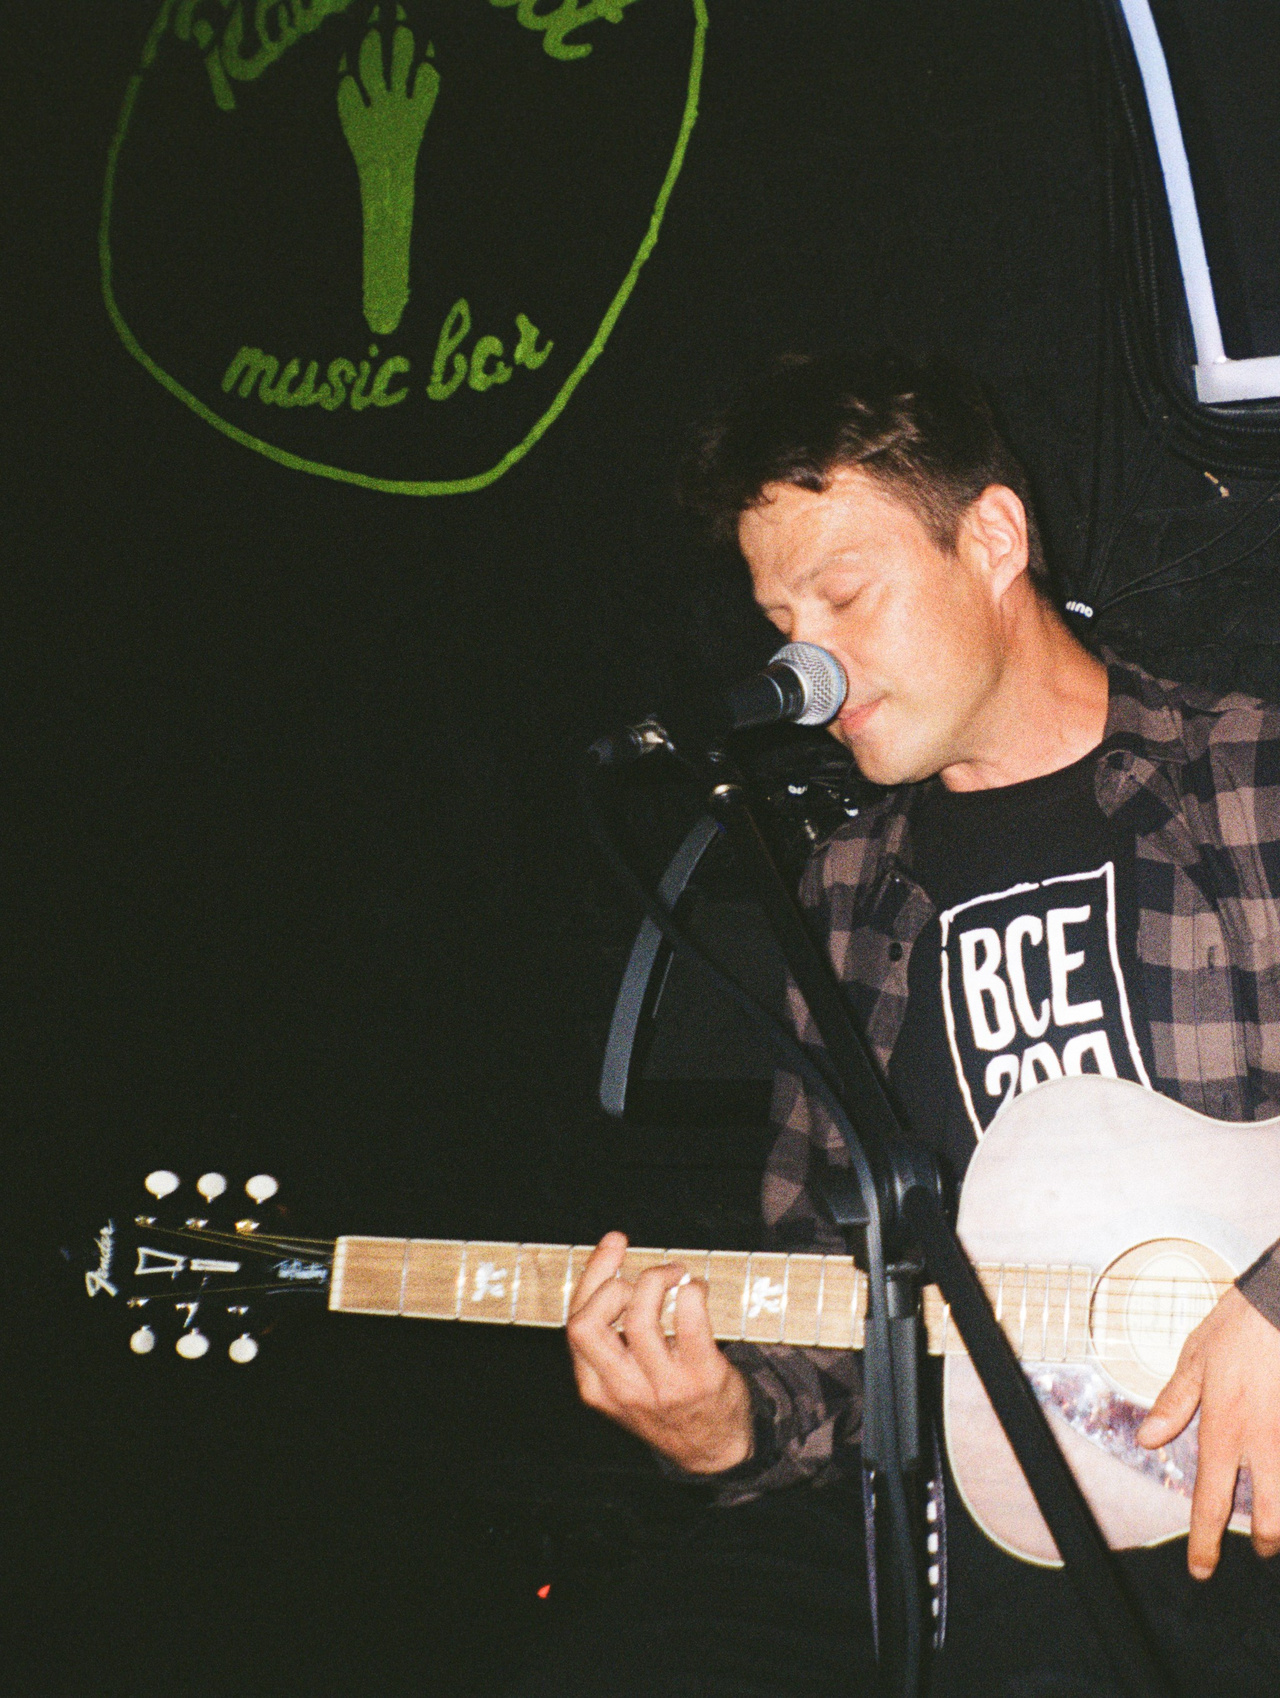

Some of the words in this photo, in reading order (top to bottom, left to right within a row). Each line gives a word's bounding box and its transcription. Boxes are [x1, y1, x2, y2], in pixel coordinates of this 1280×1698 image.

[222, 344, 410, 411] music
[426, 298, 554, 400] bar
[959, 905, 1104, 1051] ВСЕ
[85, 1218, 118, 1298] Fender
